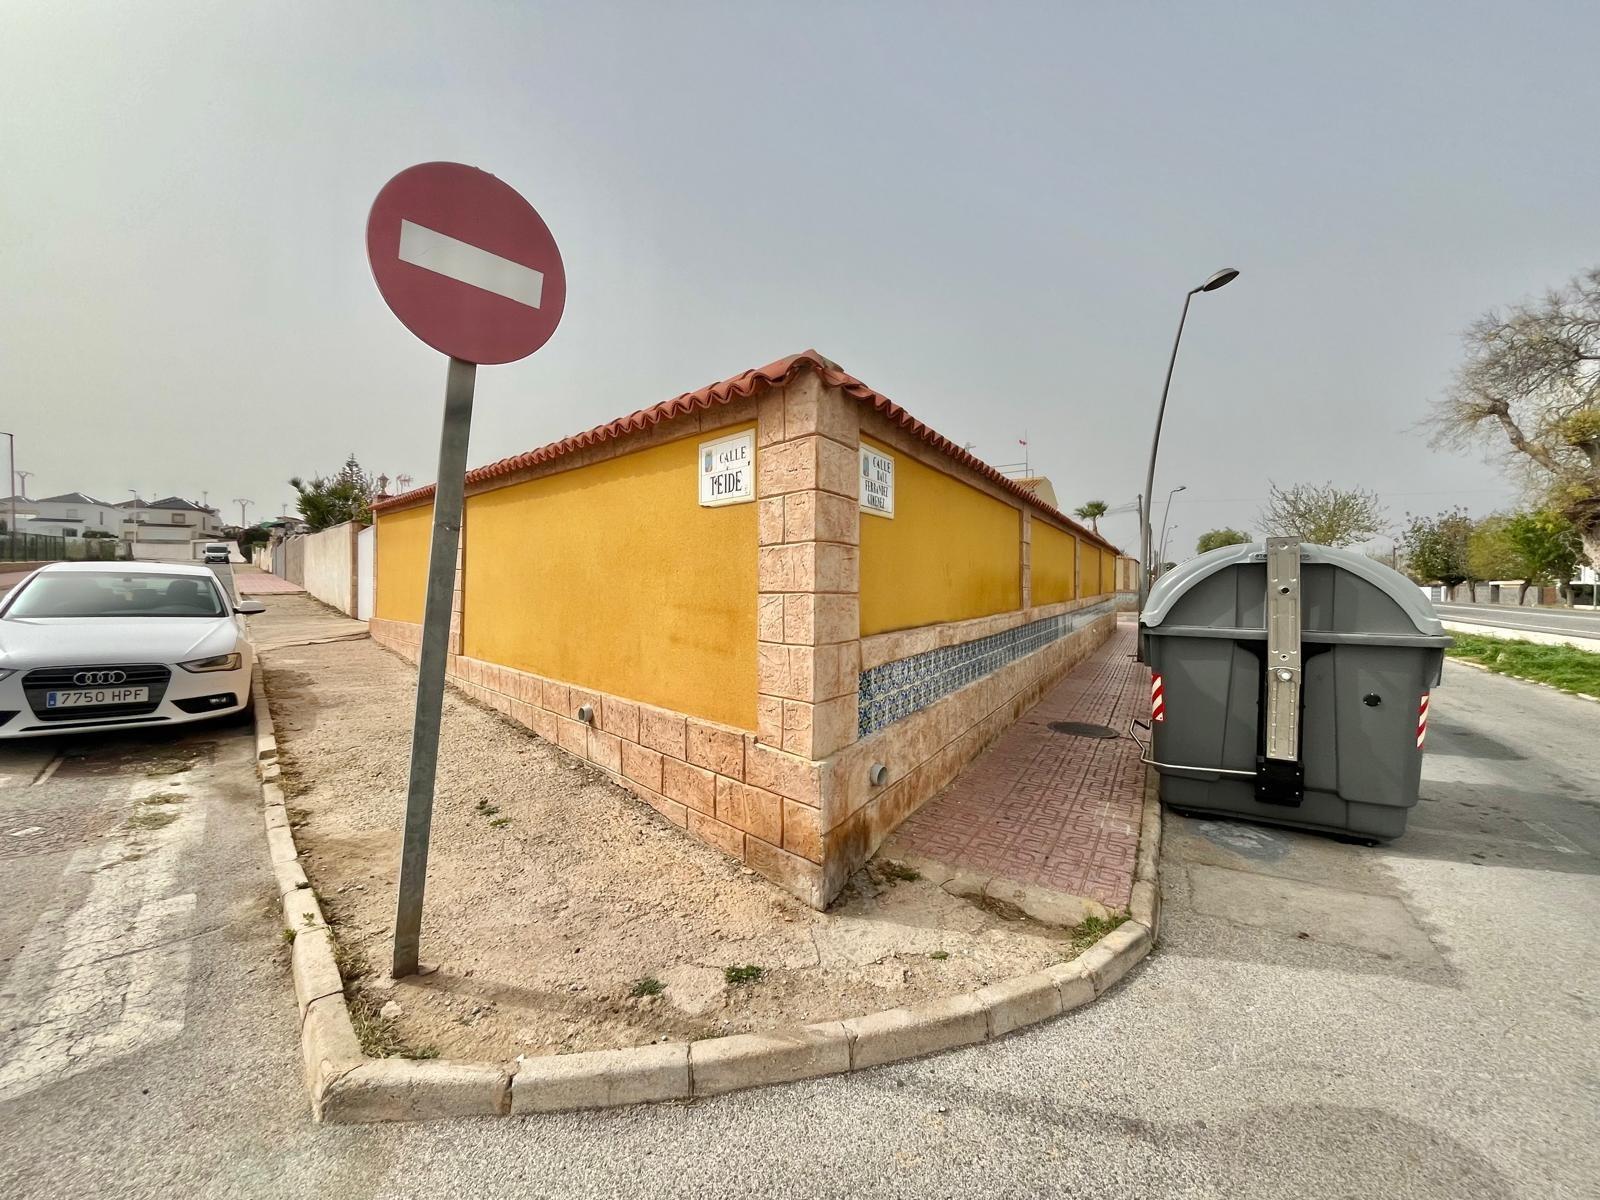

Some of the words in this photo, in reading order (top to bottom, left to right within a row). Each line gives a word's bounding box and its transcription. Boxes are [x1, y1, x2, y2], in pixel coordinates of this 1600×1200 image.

[720, 446, 747, 464] CALLE
[873, 456, 891, 473] CALLE
[710, 470, 743, 496] TEIDE
[61, 691, 105, 705] 7750
[112, 689, 144, 701] HPF
